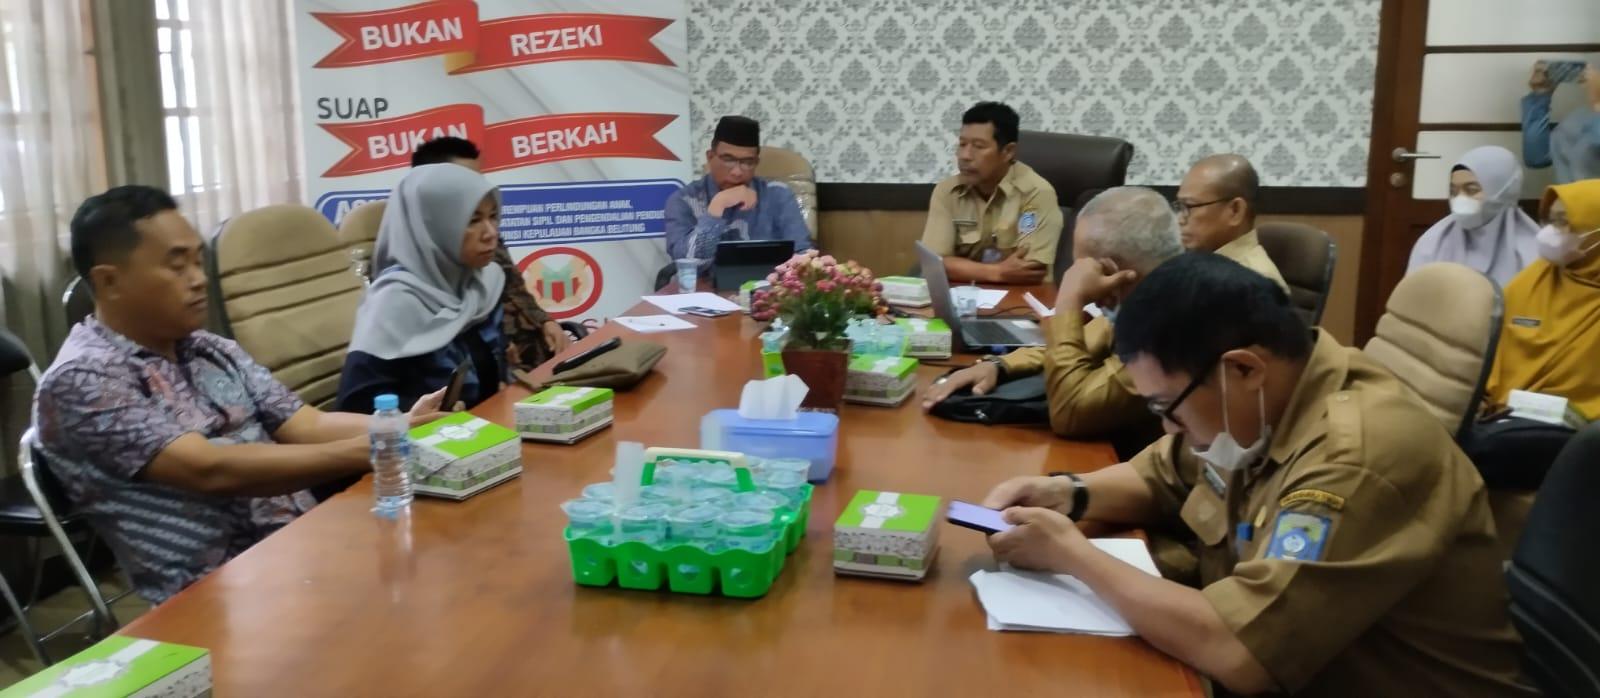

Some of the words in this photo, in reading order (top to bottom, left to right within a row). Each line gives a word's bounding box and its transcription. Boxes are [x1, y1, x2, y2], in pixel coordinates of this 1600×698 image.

[360, 16, 463, 51] BUKAN
[510, 24, 603, 57] REZEKI
[317, 97, 389, 119] SUAP
[511, 120, 618, 159] BERKAH
[522, 227, 572, 239] KEPULAUAN
[607, 222, 646, 234] BELITUNG
[532, 214, 554, 226] SIPIL
[555, 214, 574, 225] DAN
